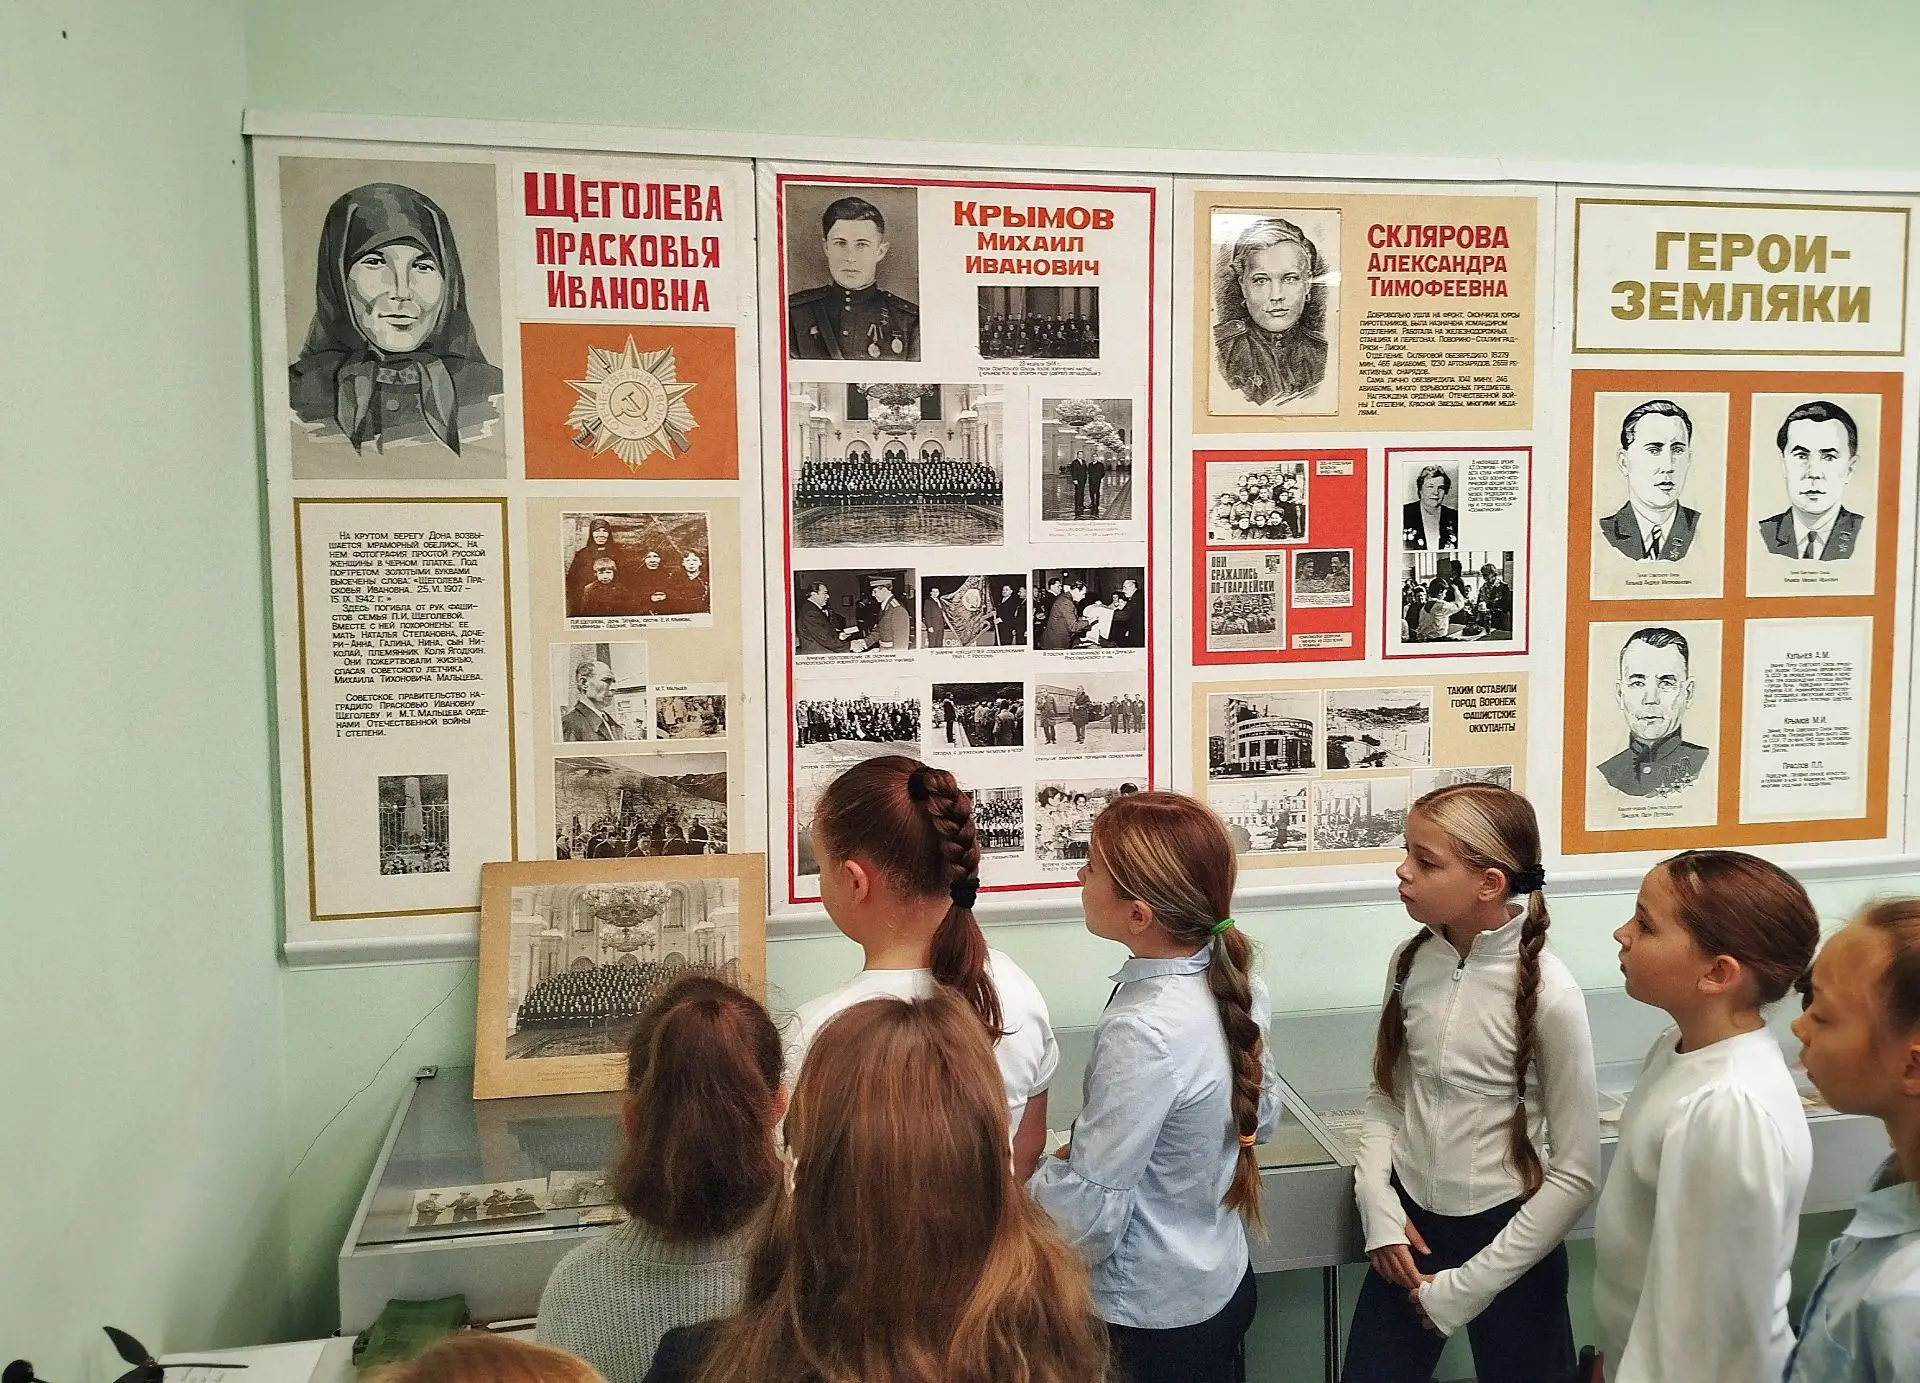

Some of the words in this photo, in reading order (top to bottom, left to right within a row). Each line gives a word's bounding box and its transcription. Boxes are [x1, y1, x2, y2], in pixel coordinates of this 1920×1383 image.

[524, 172, 722, 222] ЩЕГОЛЕВА
[954, 200, 1115, 230] КРЫМОВ
[977, 232, 1084, 252] МИХАИЛ
[1368, 224, 1509, 249] СКЛЯРОВА
[536, 228, 720, 268] ПРАСКОВЬЯ
[1655, 232, 1850, 274] ГЕРОИ-
[965, 256, 1099, 275] ИВАНОВИЧ
[1368, 253, 1507, 275] АЛЕКСАНДРА
[547, 271, 710, 312] ИВАНОВНА
[1368, 277, 1508, 297] ТИМОФЕЕВНА
[1611, 281, 1871, 323] ЗЕМЛЯКИ
[1212, 557, 1226, 567] ОНИ
[1211, 568, 1258, 580] СРАЖАЛИСЬ
[1447, 686, 1473, 694] ТАКИМ
[1476, 684, 1517, 693] ОСТАВИЛИ
[1463, 710, 1516, 719] ФАШИСТСКИЕ
[1469, 723, 1515, 732] ОККУПАНТЫ
